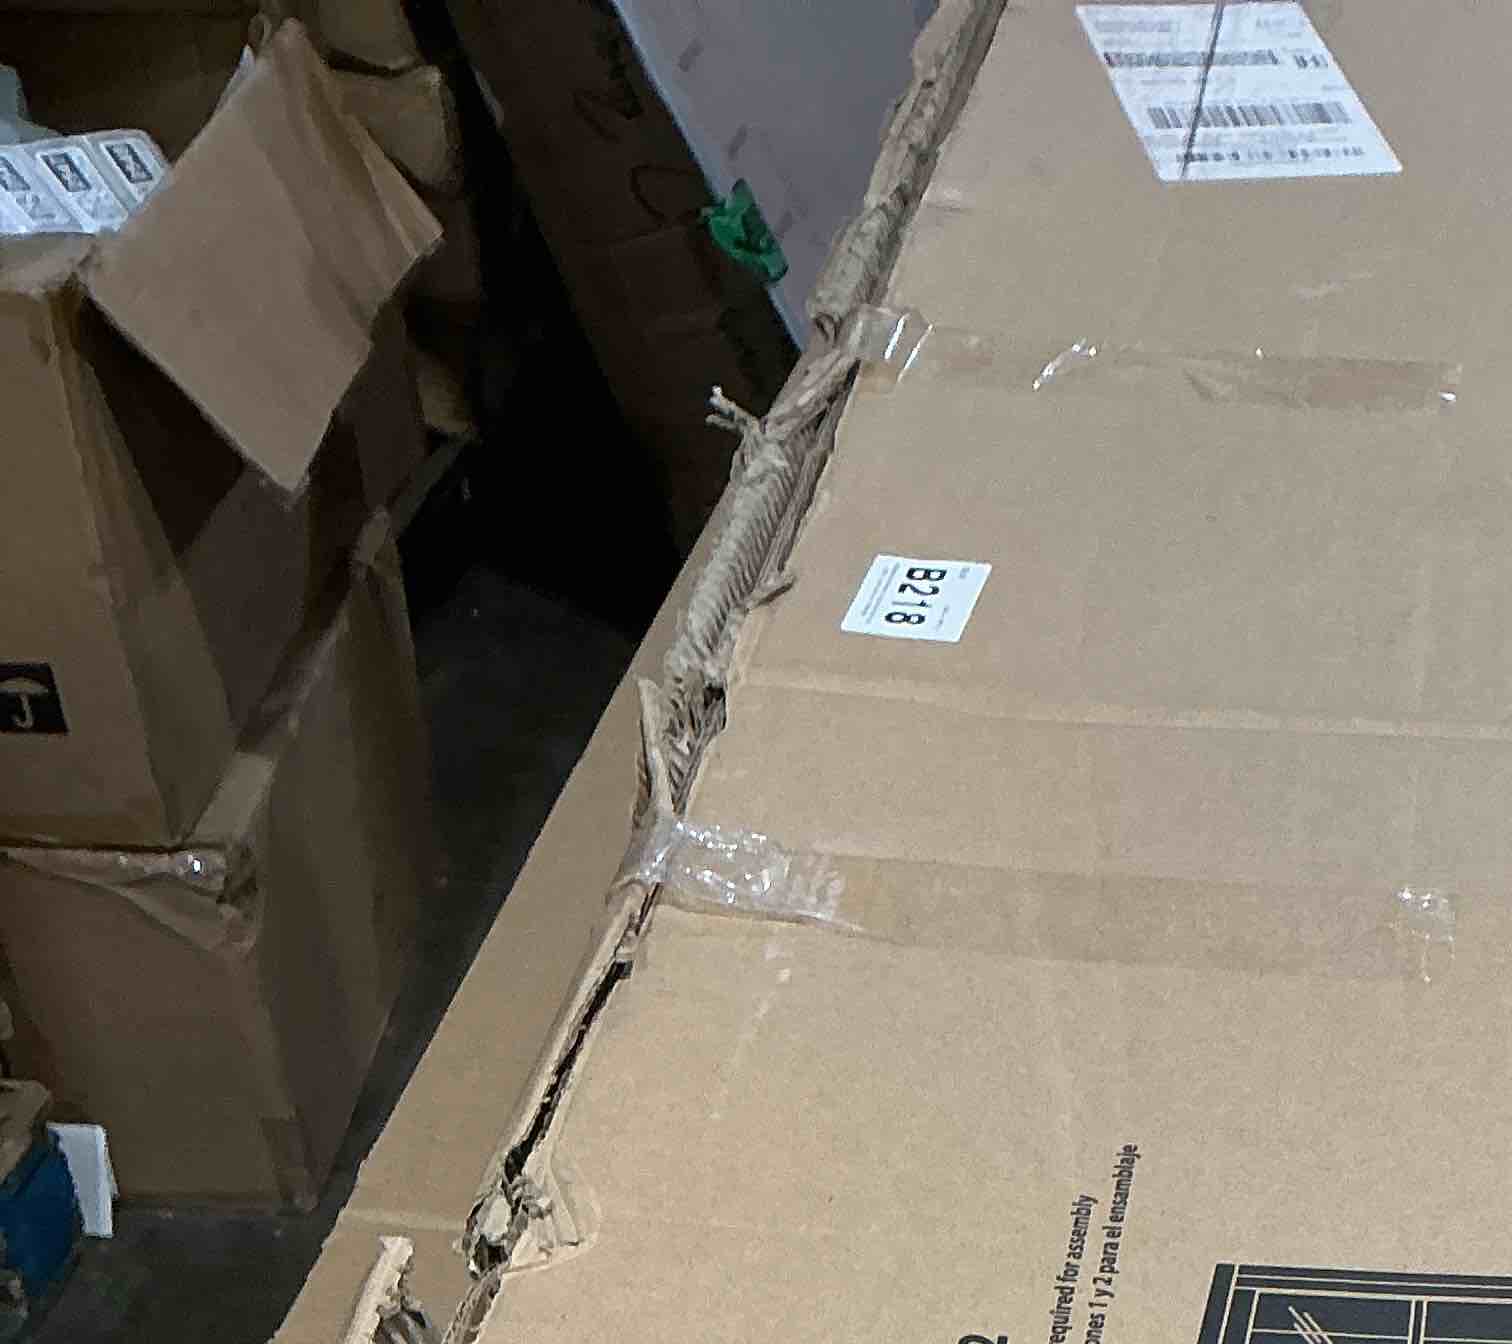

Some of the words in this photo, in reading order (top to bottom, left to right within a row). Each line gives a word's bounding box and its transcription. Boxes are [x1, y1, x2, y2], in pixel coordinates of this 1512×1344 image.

[885, 567, 947, 625] B218
[1109, 1145, 1141, 1222] ensamblaje
[1067, 1195, 1098, 1259] assembly
[1102, 1226, 1122, 1238] el
[1100, 1242, 1119, 1274] para
[1056, 1262, 1080, 1282] for
[1093, 1277, 1112, 1286] 2
[1094, 1288, 1114, 1298] y
